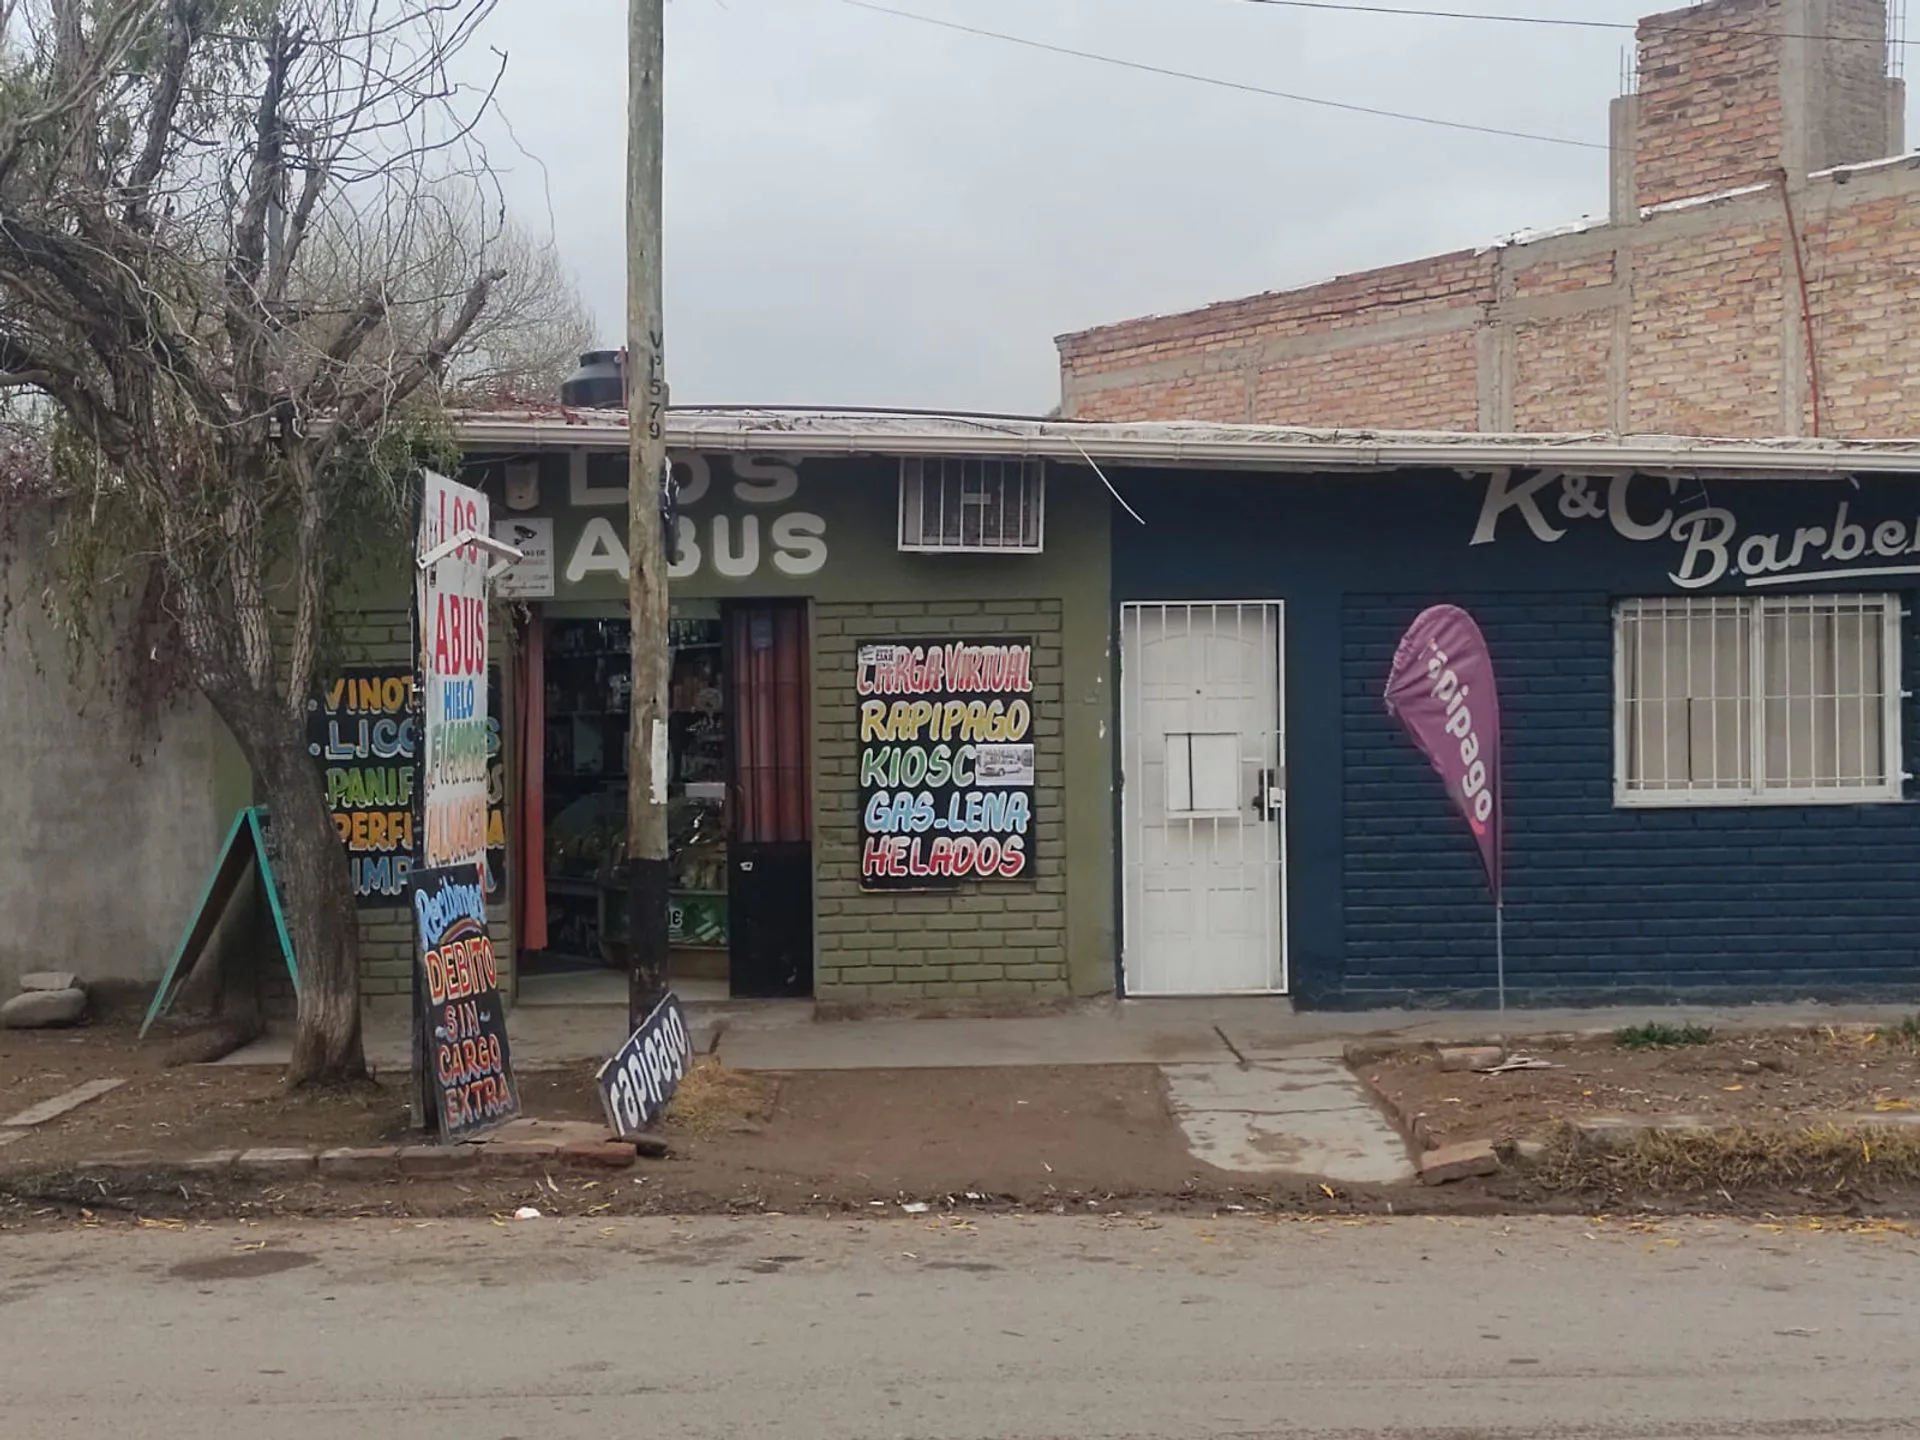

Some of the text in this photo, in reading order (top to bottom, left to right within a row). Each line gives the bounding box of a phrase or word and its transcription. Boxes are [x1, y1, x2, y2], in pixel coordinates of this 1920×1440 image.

[569, 449, 798, 505] LOS
[439, 489, 478, 565] LOS
[566, 512, 828, 582] ABUS
[1668, 502, 1920, 588] Barbe
[435, 592, 485, 676] ABUS
[325, 671, 414, 715] VINOT
[944, 641, 1033, 693] VIRTUAL
[444, 680, 474, 720] HIELO
[861, 699, 1031, 742] RAPIPAGO
[860, 743, 978, 788] KIOSC
[862, 834, 1027, 877] HELADOS
[424, 935, 497, 1006] DEBITO
[444, 1000, 481, 1042] SIN
[437, 1033, 502, 1087] CARGO
[610, 1006, 687, 1136] rapipago
[445, 1072, 513, 1129] EXTRA
